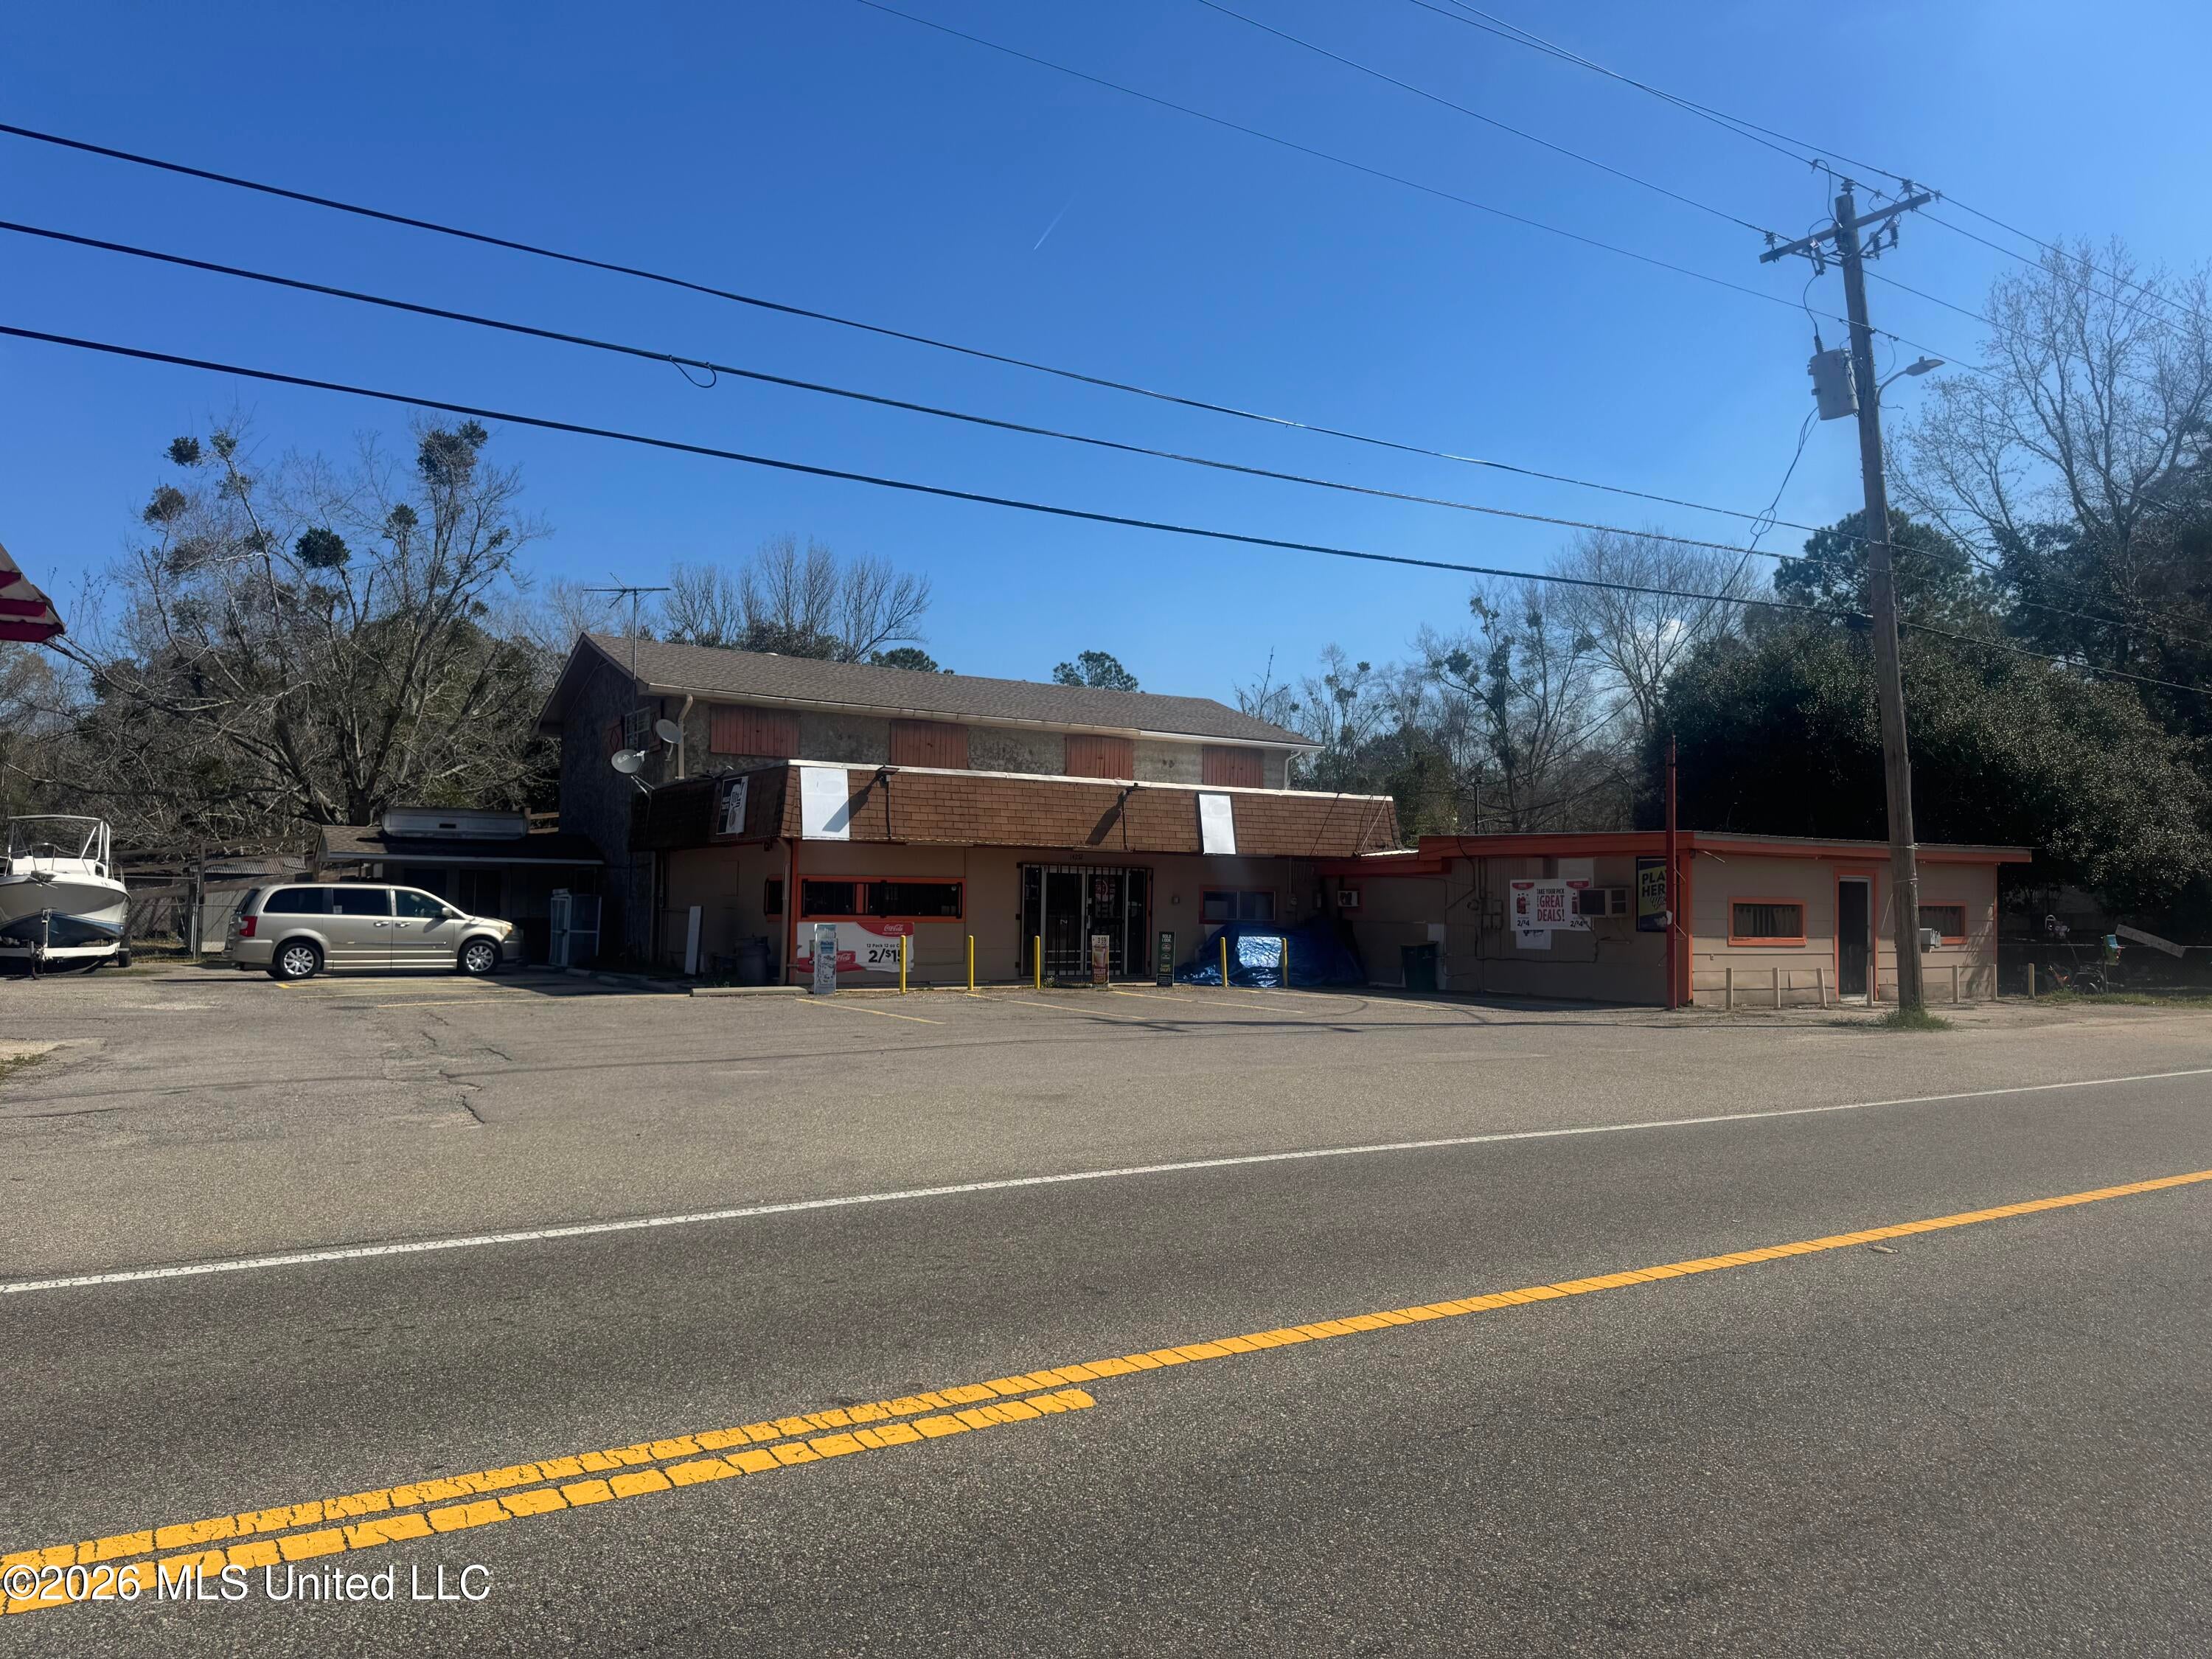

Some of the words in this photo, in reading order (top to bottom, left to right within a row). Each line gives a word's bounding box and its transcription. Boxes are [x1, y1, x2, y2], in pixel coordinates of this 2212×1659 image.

[1642, 871, 1666, 884] PLA
[1642, 883, 1666, 897] HER
[1540, 895, 1565, 908] GREAT
[1537, 908, 1565, 922] DEALS!
[884, 924, 903, 932] Coca-Cola
